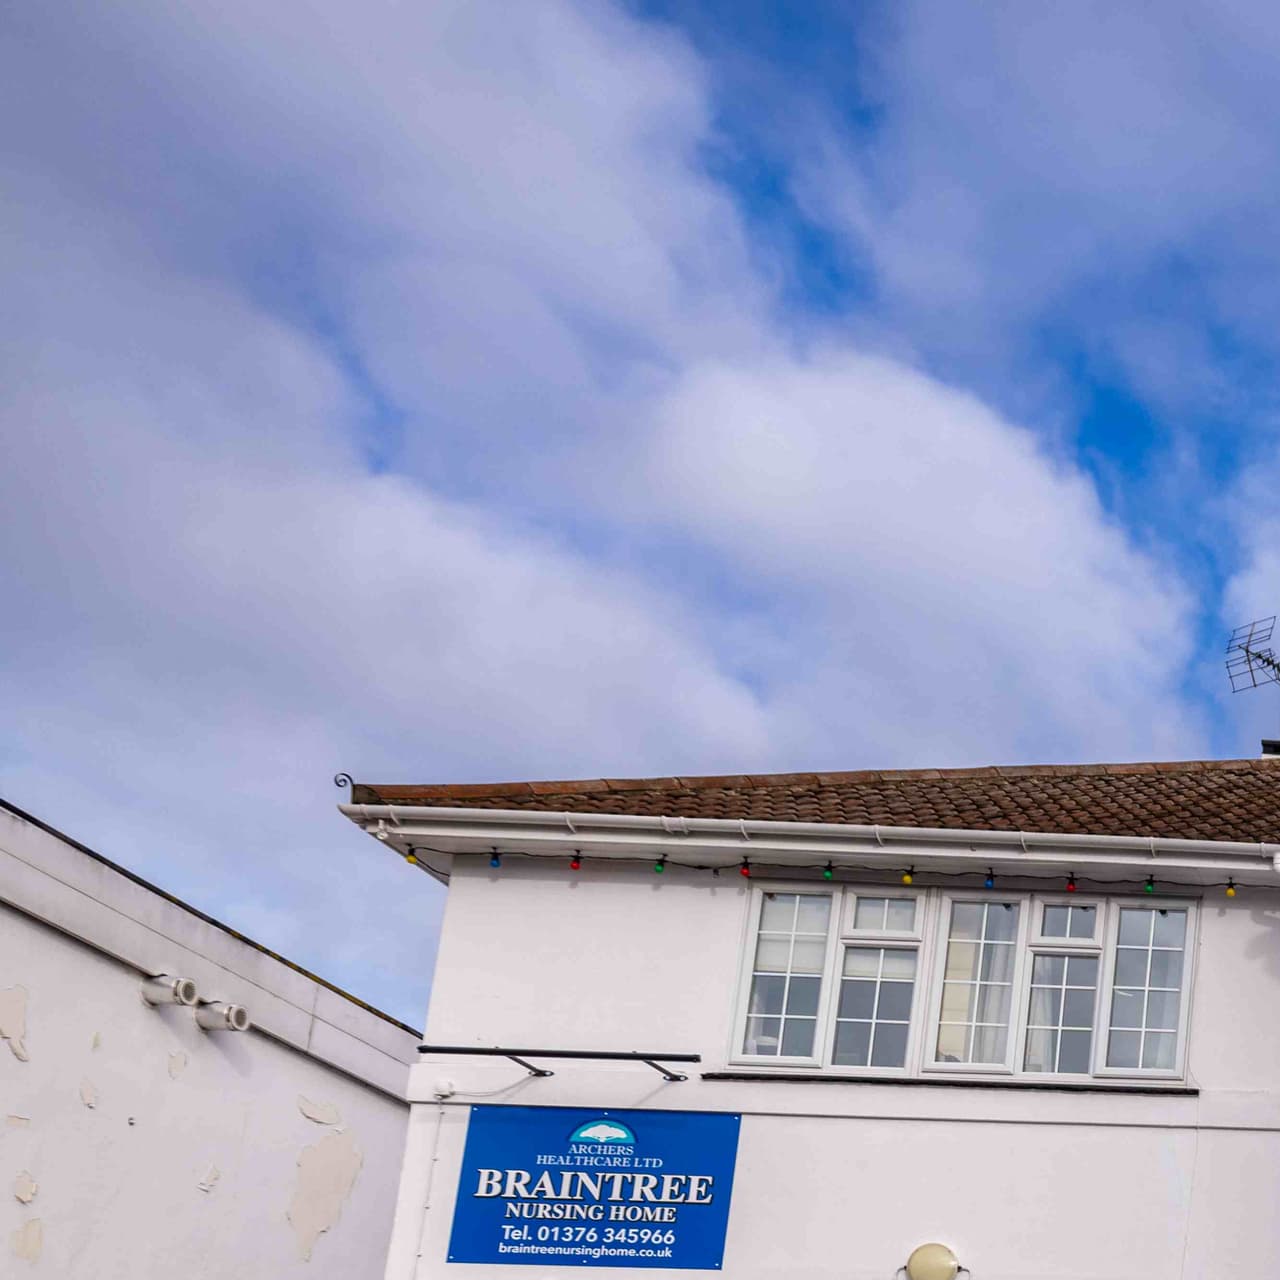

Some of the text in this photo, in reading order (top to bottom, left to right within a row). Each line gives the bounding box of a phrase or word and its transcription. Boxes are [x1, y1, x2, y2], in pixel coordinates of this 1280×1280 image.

[568, 1144, 634, 1155] ARCHERS
[536, 1155, 663, 1169] HEALTHCARE LTD
[474, 1168, 714, 1204] BRAINTREE
[504, 1202, 677, 1223] NURSING HOME
[502, 1225, 676, 1245] Tel. 01376 345966
[498, 1242, 673, 1258] braintreenursinghome.co.uk
